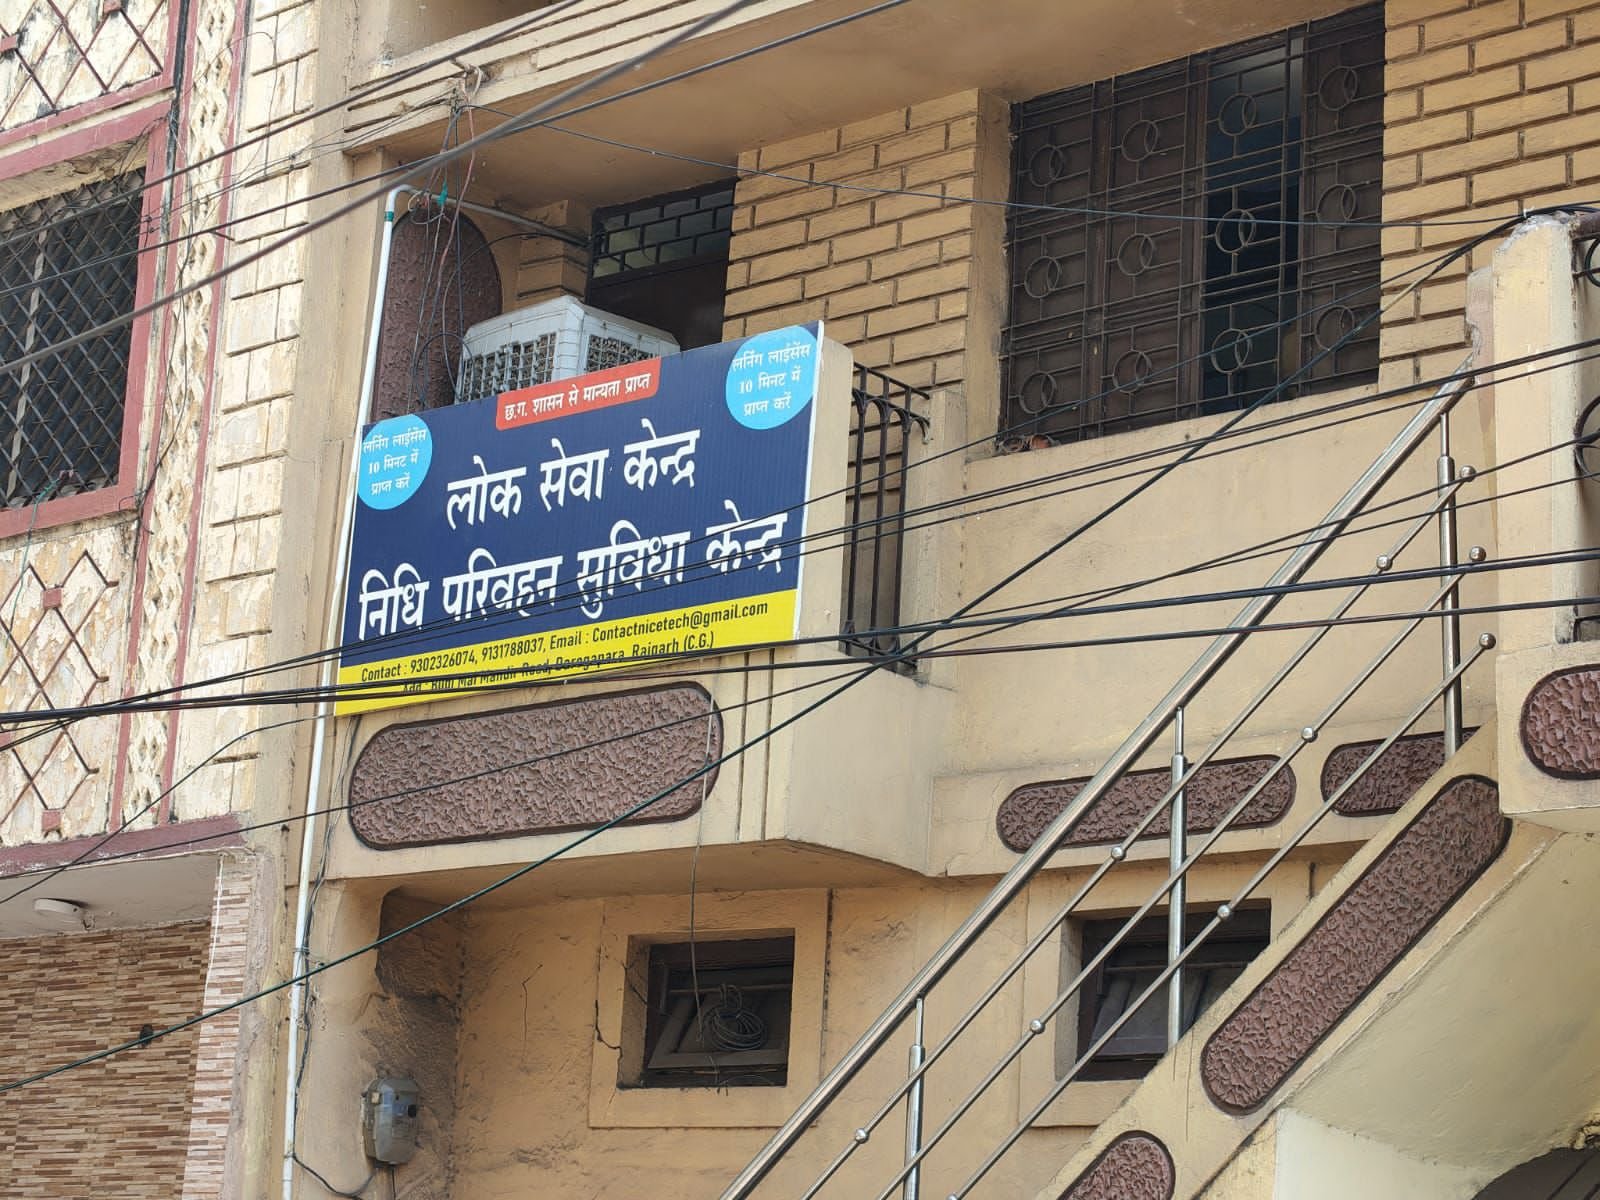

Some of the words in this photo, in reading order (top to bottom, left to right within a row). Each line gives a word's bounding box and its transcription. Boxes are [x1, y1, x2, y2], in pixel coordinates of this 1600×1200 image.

[738, 379, 753, 394] 10
[758, 371, 786, 390] मिनट
[791, 365, 801, 382] में
[504, 402, 528, 420] छ.ग.
[532, 393, 564, 415] शासन
[568, 383, 579, 407] से
[583, 380, 621, 401] मान्यता
[625, 373, 652, 394] प्राप्त
[743, 400, 768, 416] प्राप्त
[773, 391, 792, 409] करें
[369, 461, 380, 474] 10
[383, 453, 407, 472] मिनट
[410, 448, 419, 464] में
[446, 455, 527, 530] लोक
[539, 438, 610, 512] सेवा
[624, 417, 701, 491] केन्द्र
[371, 480, 393, 496] प्राप्त
[395, 472, 410, 489] करें
[358, 562, 430, 640] निधि
[442, 547, 564, 621] परिवहन
[576, 519, 691, 620] सुविधा
[705, 499, 788, 575] केन्द्र
[361, 663, 401, 682] Contact
[410, 650, 478, 674] 9302326074,
[481, 637, 546, 661] 9131788037,
[550, 630, 582, 650] Email
[592, 602, 768, 643] Contactnicetech@gmail.com
[683, 631, 714, 654] (C.G.)
